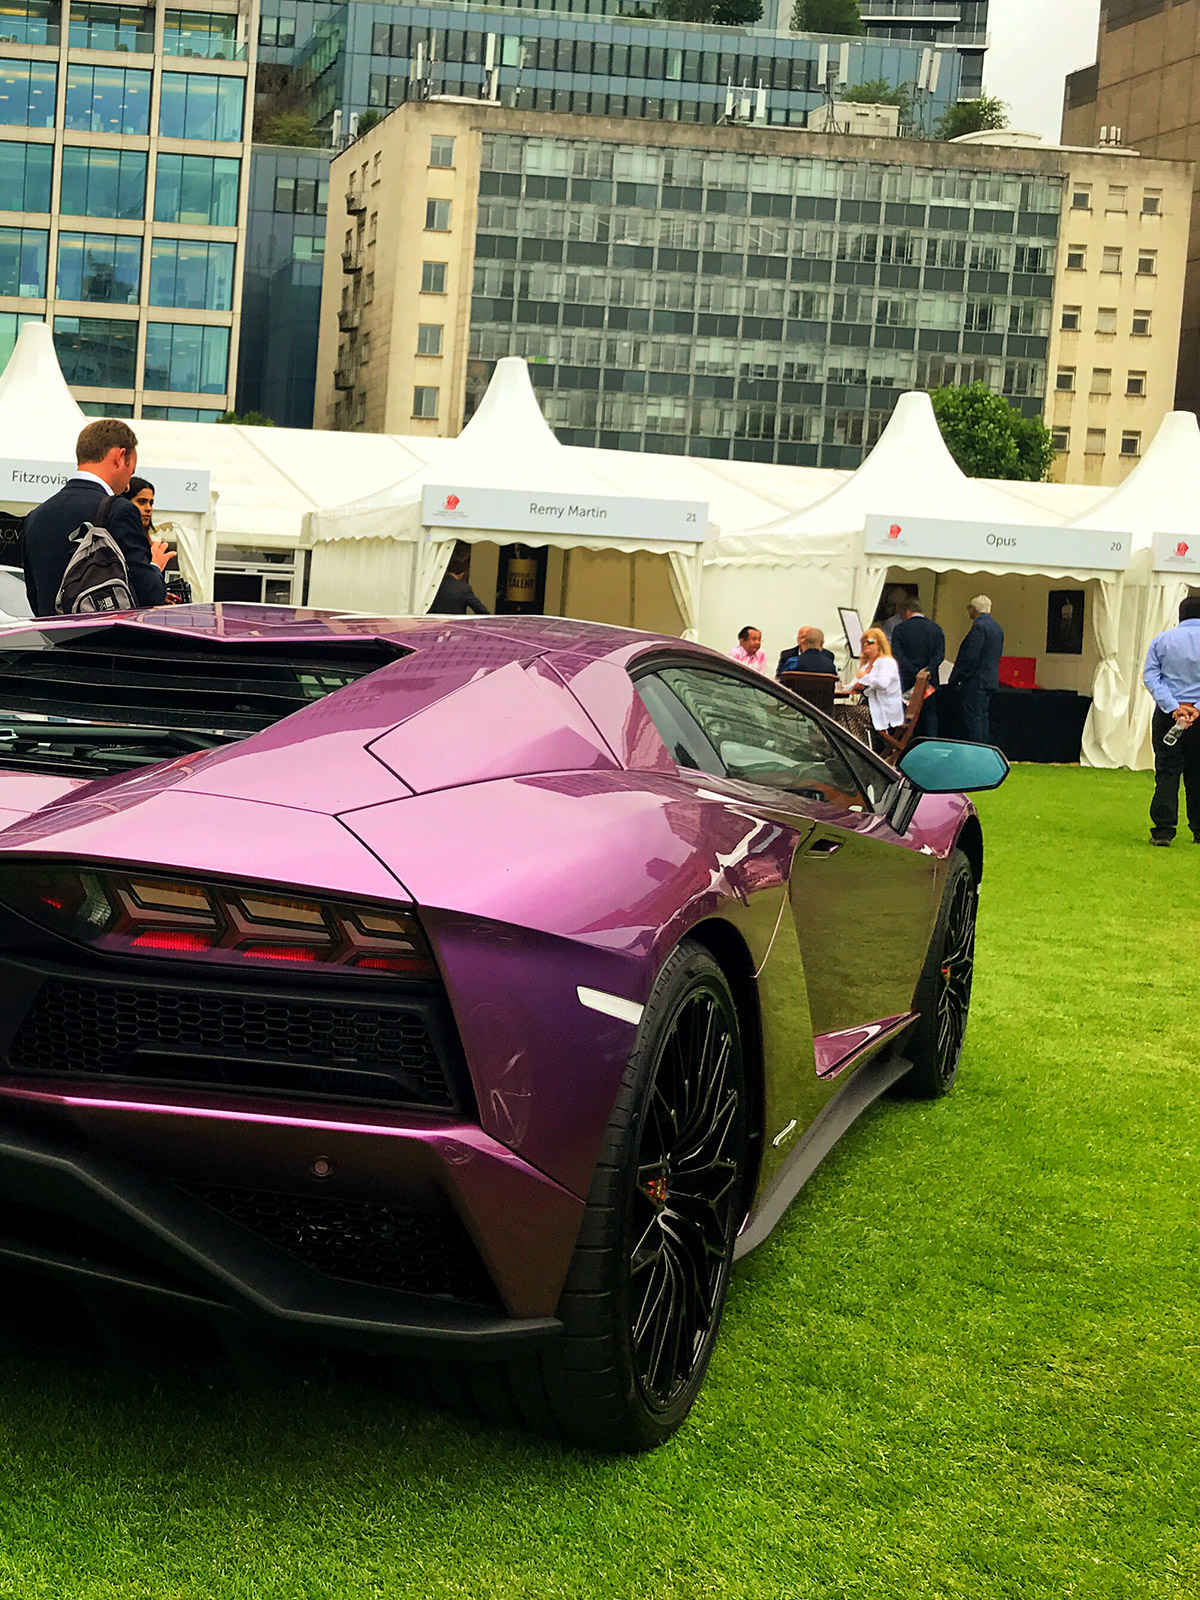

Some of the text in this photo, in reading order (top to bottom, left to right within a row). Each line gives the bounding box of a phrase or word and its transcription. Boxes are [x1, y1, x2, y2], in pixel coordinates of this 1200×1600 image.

[11, 470, 198, 492] Fitzrovia 22
[529, 502, 697, 522] Remy Martin 21
[985, 533, 1122, 551] Opus 20
